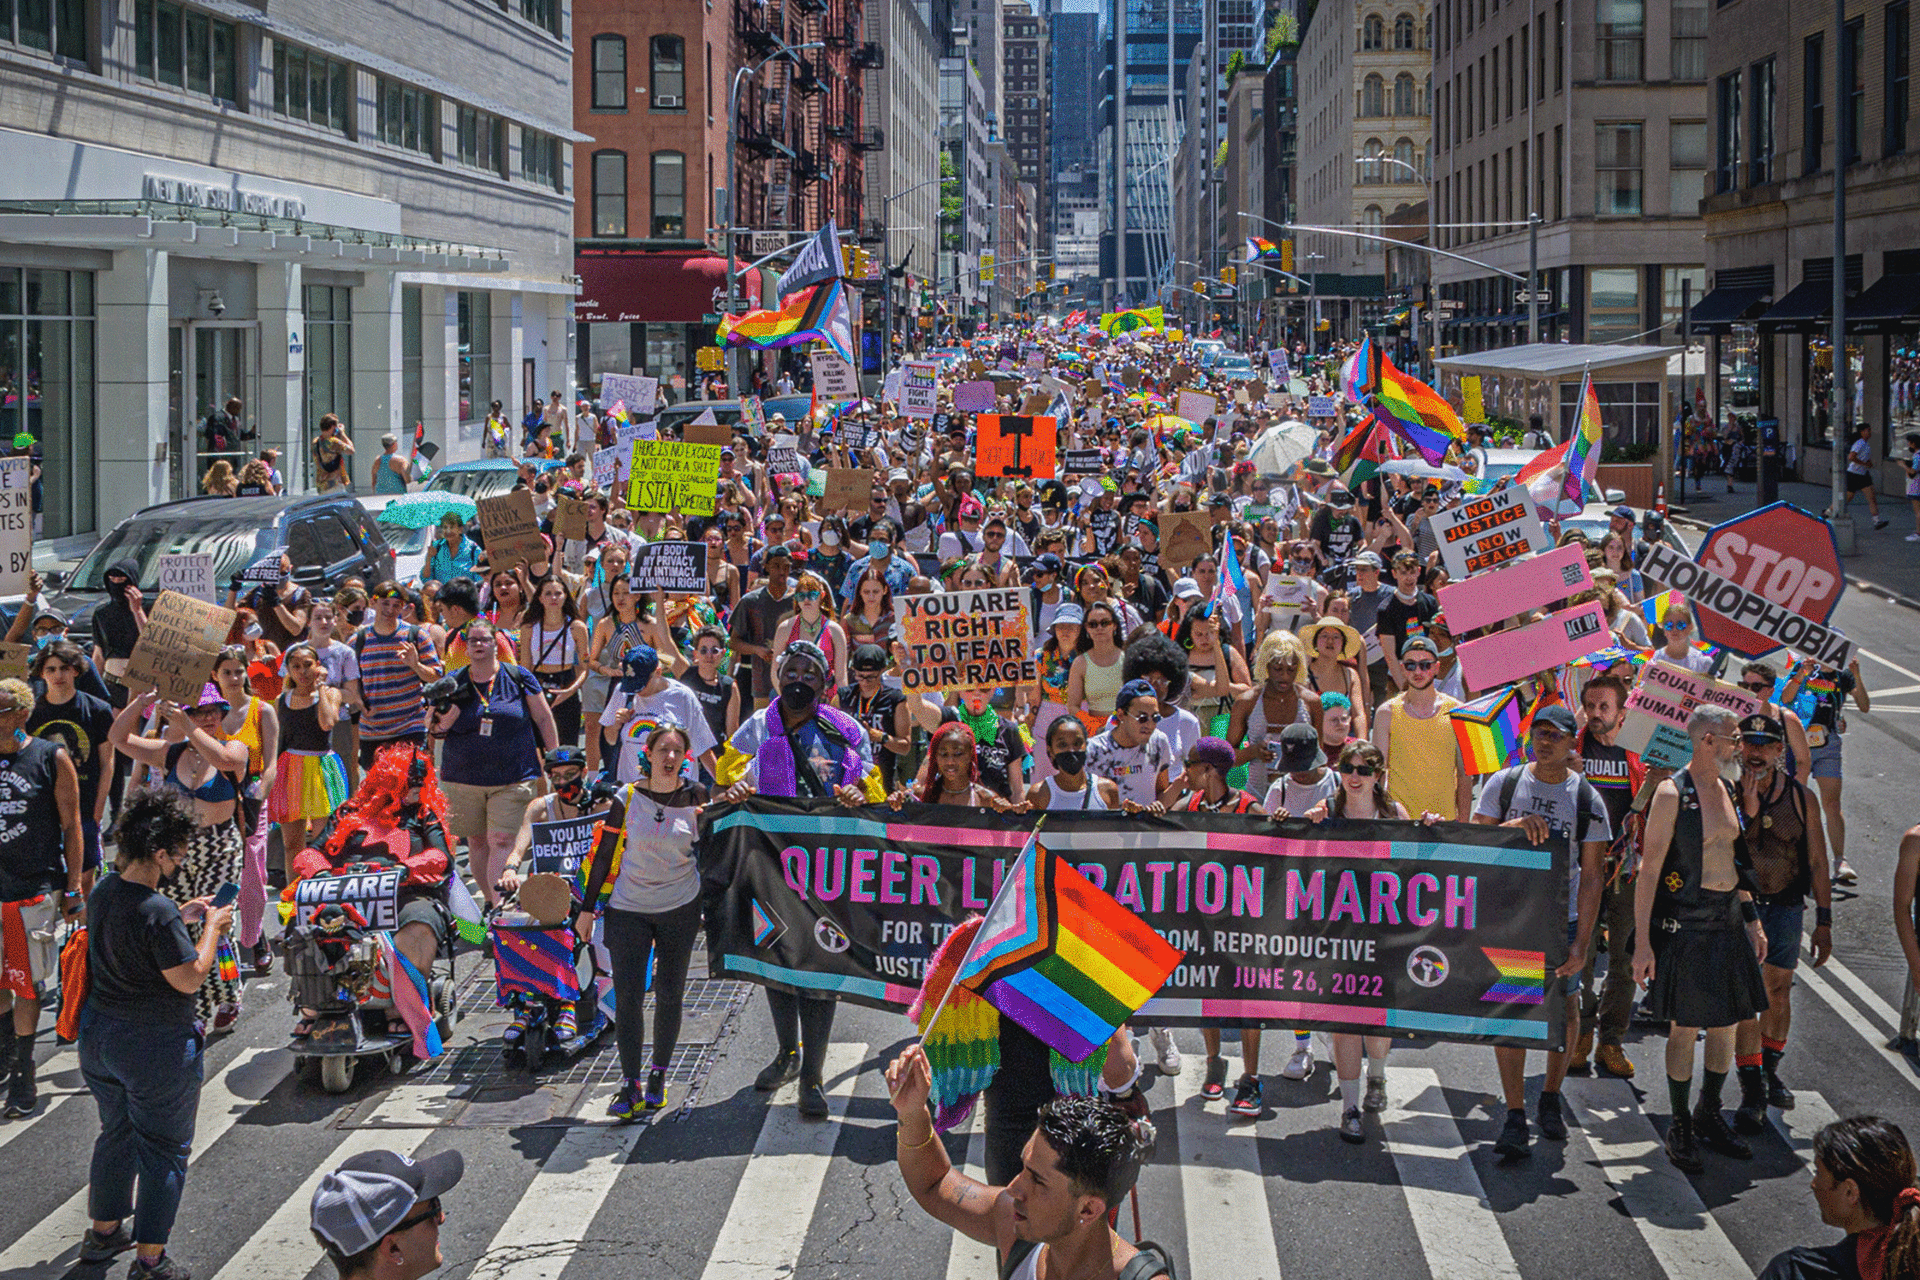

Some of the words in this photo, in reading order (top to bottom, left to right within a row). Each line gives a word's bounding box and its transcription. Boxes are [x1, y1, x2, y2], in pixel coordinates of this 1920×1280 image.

[756, 237, 785, 254] SHOES
[908, 389, 929, 398] FIGHT
[15, 492, 28, 508] IN
[627, 480, 679, 509] LISTEN
[1452, 493, 1510, 523] KNOW
[1445, 504, 1526, 542] JUSTICE
[651, 544, 662, 556] MY
[663, 544, 689, 556] BODY
[1463, 526, 1521, 558] KNOW
[10, 551, 30, 574] BY
[160, 555, 211, 568] PROTECT
[643, 555, 656, 567] MY
[656, 555, 695, 568] PRIVACY
[1467, 541, 1530, 571] PEACE
[163, 568, 207, 585] QUEER
[260, 570, 281, 580] FREE
[630, 577, 644, 589] MY
[645, 577, 676, 589] HUMAN
[677, 578, 706, 589] RIGHT
[640, 566, 652, 578] MY
[654, 566, 697, 578] INTIMACY
[1705, 531, 1835, 617] STOP
[905, 595, 959, 618] YOU
[969, 592, 1020, 613] ARE
[1643, 546, 1851, 671] HOMOPHOBIA
[925, 616, 1004, 640] RIGHT
[1566, 617, 1584, 636] ACT
[1583, 613, 1599, 631] UP
[912, 643, 947, 664] TO
[956, 638, 1022, 661] FEAR
[151, 657, 183, 678] FUCK
[903, 665, 959, 689] OUR
[967, 661, 1036, 684] RAGE
[1648, 667, 1698, 697] EQUAL
[1701, 688, 1755, 715] RIGHTS
[1582, 757, 1629, 777] QUALIT
[1531, 796, 1559, 815] THE
[550, 827, 575, 843] YOU
[563, 855, 581, 871] ON
[302, 879, 341, 902] WE
[341, 874, 397, 900] ARE
[780, 846, 942, 906] QUEER
[962, 857, 1265, 918] LIRATION
[1285, 868, 1478, 931] MARCH
[881, 920, 922, 944] FOR
[1213, 930, 1377, 963] REPRODUCTIVE
[1233, 965, 1285, 991] JUNE
[1292, 968, 1325, 997] 26,
[1332, 972, 1385, 998] 2022
